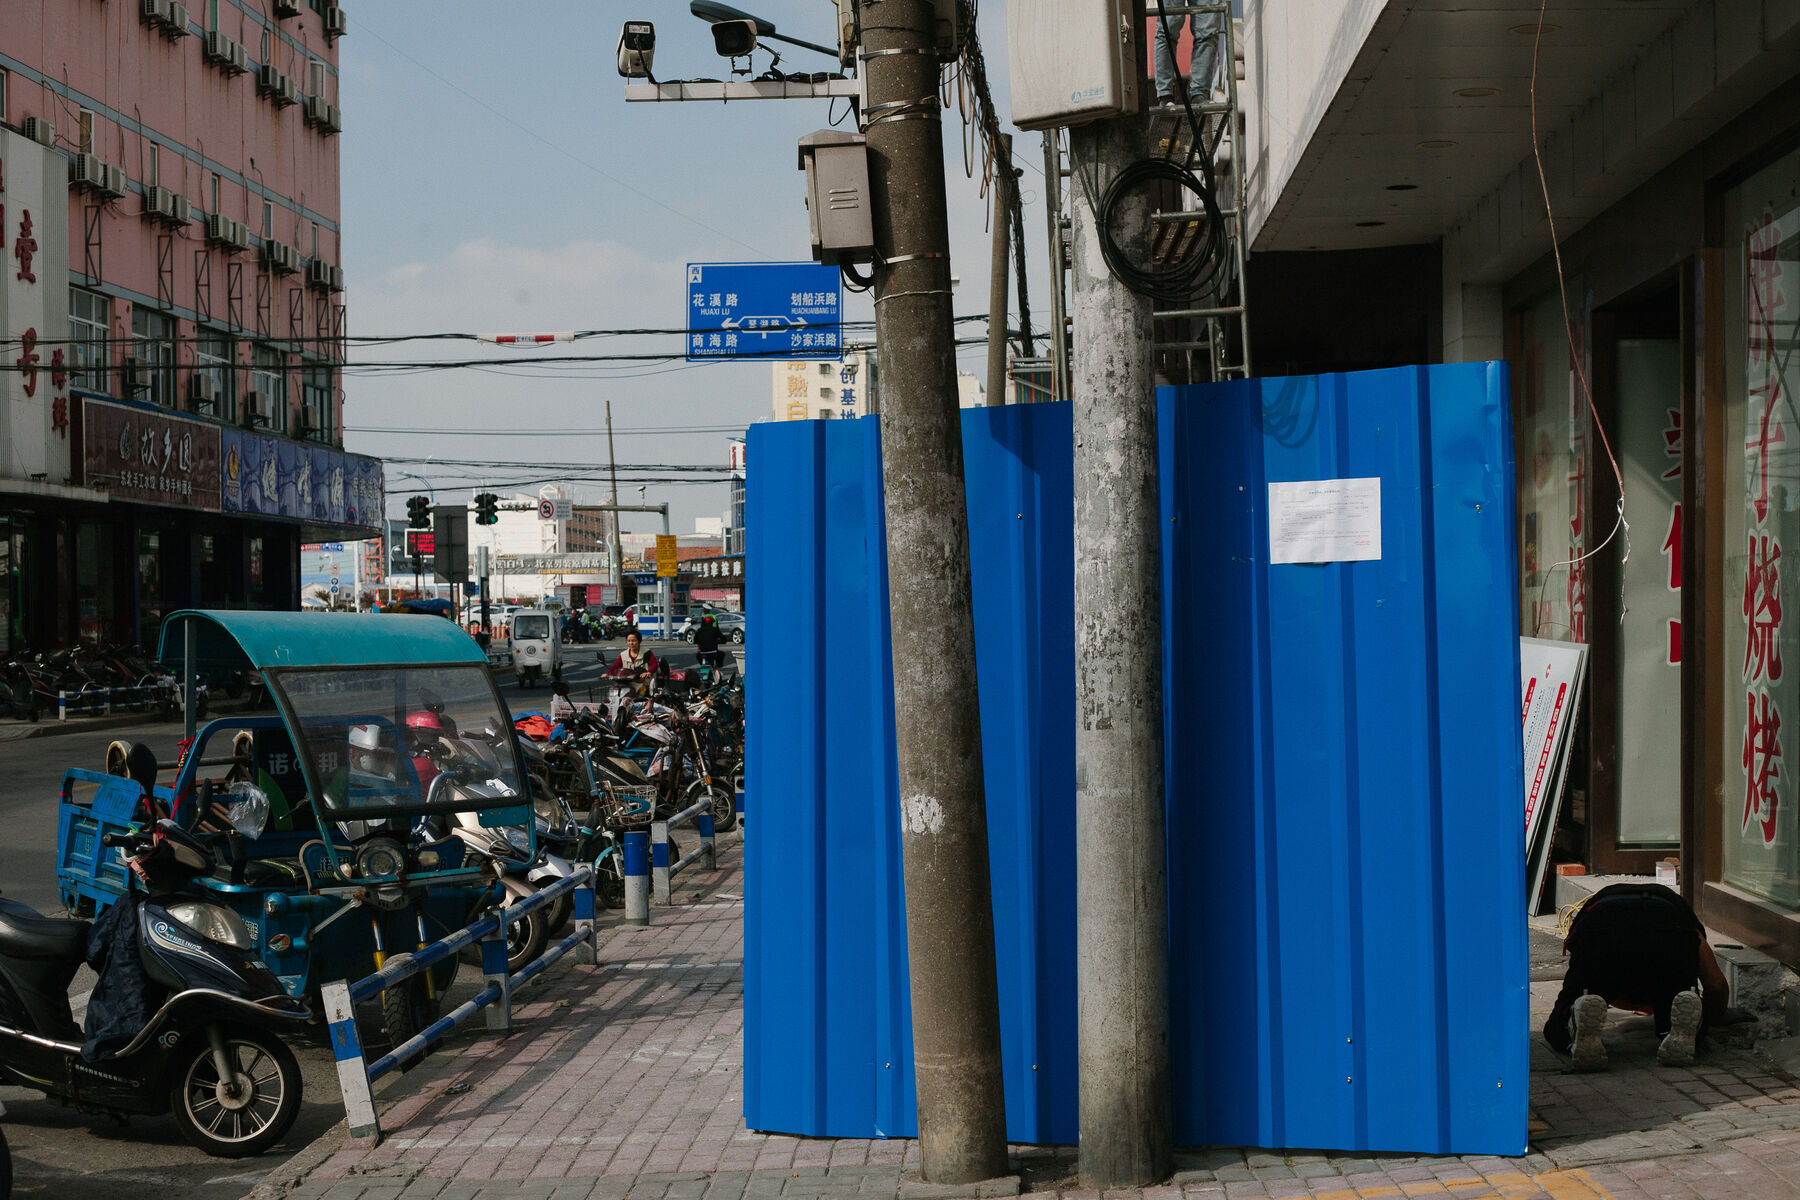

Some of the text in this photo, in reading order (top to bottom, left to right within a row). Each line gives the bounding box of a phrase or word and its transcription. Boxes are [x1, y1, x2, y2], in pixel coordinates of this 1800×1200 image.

[692, 293, 738, 307] 花溪路
[790, 292, 837, 306] 划船浜路
[701, 308, 720, 316] HUAXI
[692, 334, 738, 347] 商海路
[790, 333, 837, 347] 沙家浜路
